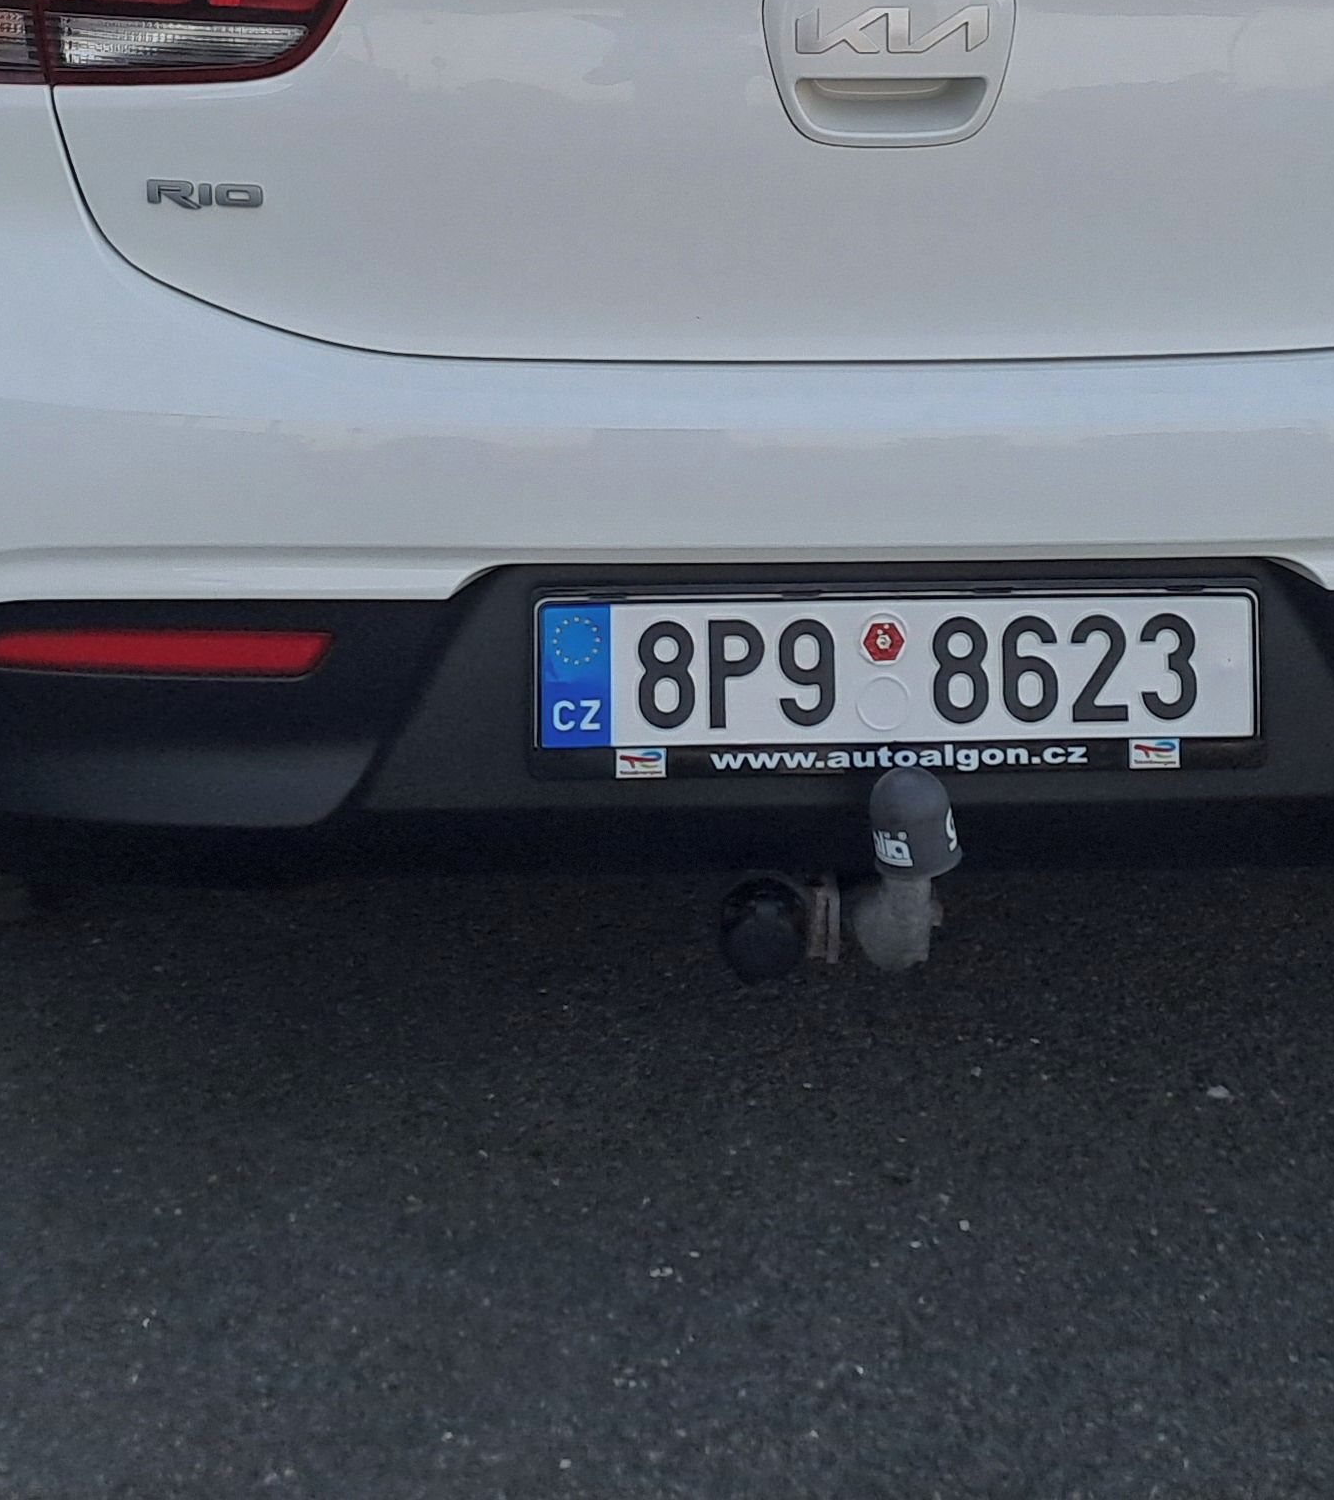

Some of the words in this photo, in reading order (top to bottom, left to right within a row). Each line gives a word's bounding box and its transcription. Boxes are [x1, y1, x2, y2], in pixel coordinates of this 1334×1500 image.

[795, 5, 989, 54] KIA
[146, 178, 264, 210] RIO
[636, 619, 836, 729] 8P9
[931, 614, 1198, 724] 8623
[552, 700, 601, 731] CZ
[710, 745, 1089, 771] www.autoalgon.cz
